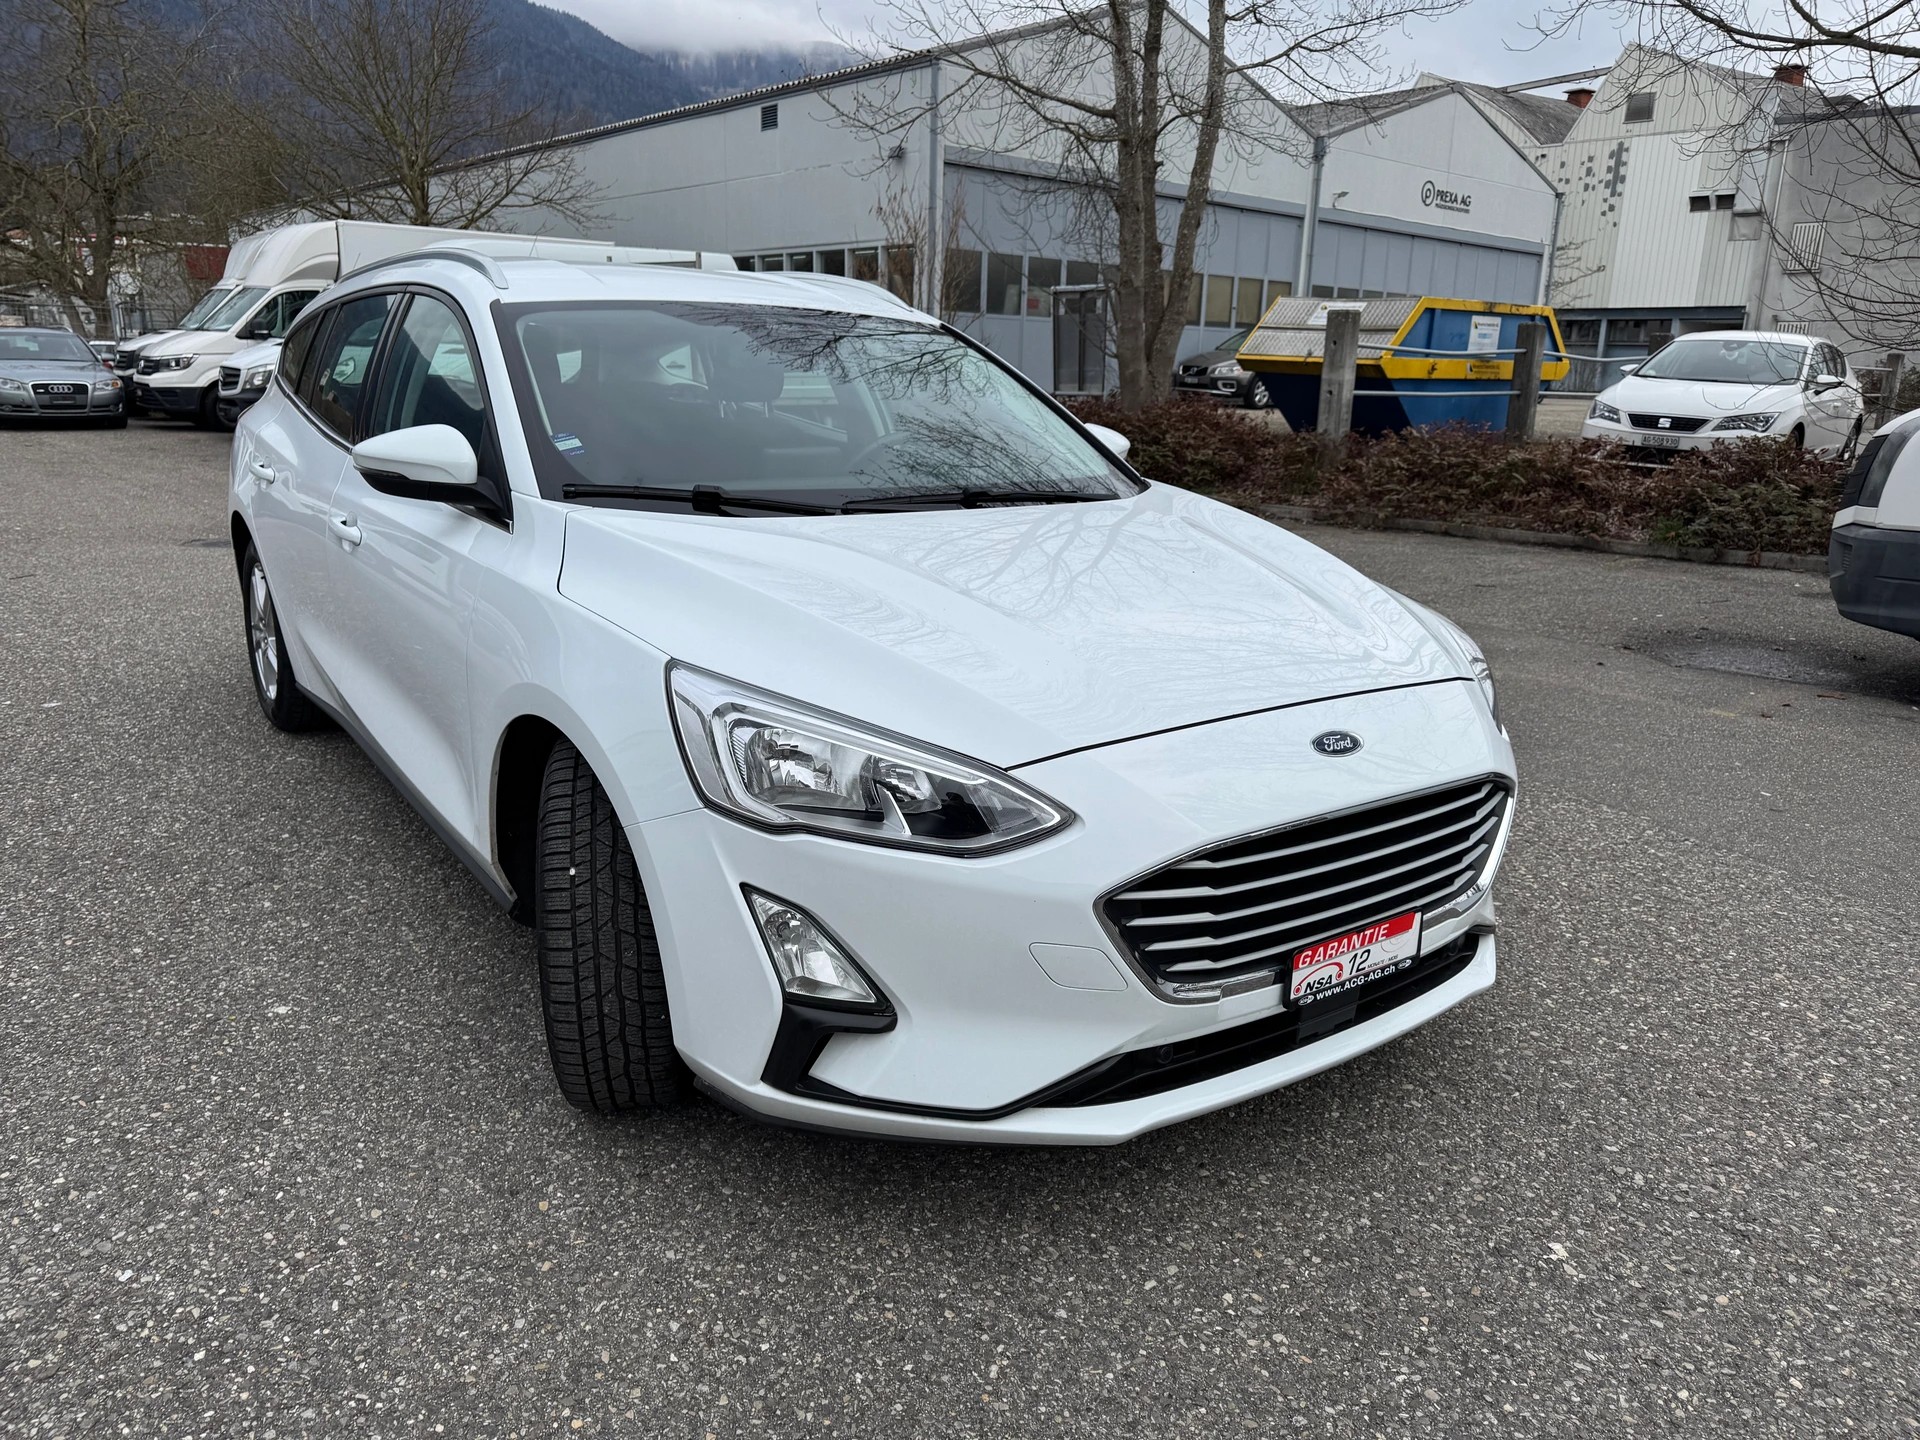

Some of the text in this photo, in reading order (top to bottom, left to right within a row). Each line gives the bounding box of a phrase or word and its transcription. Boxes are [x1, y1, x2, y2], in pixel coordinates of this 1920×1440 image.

[1435, 189, 1472, 207] PREXA AG
[1323, 734, 1354, 752] Ford
[1299, 924, 1389, 968] GARANTIE
[1348, 949, 1371, 975] 12
[1304, 975, 1332, 993] NSA
[1316, 964, 1395, 1000] www.ACG-AG.ch
